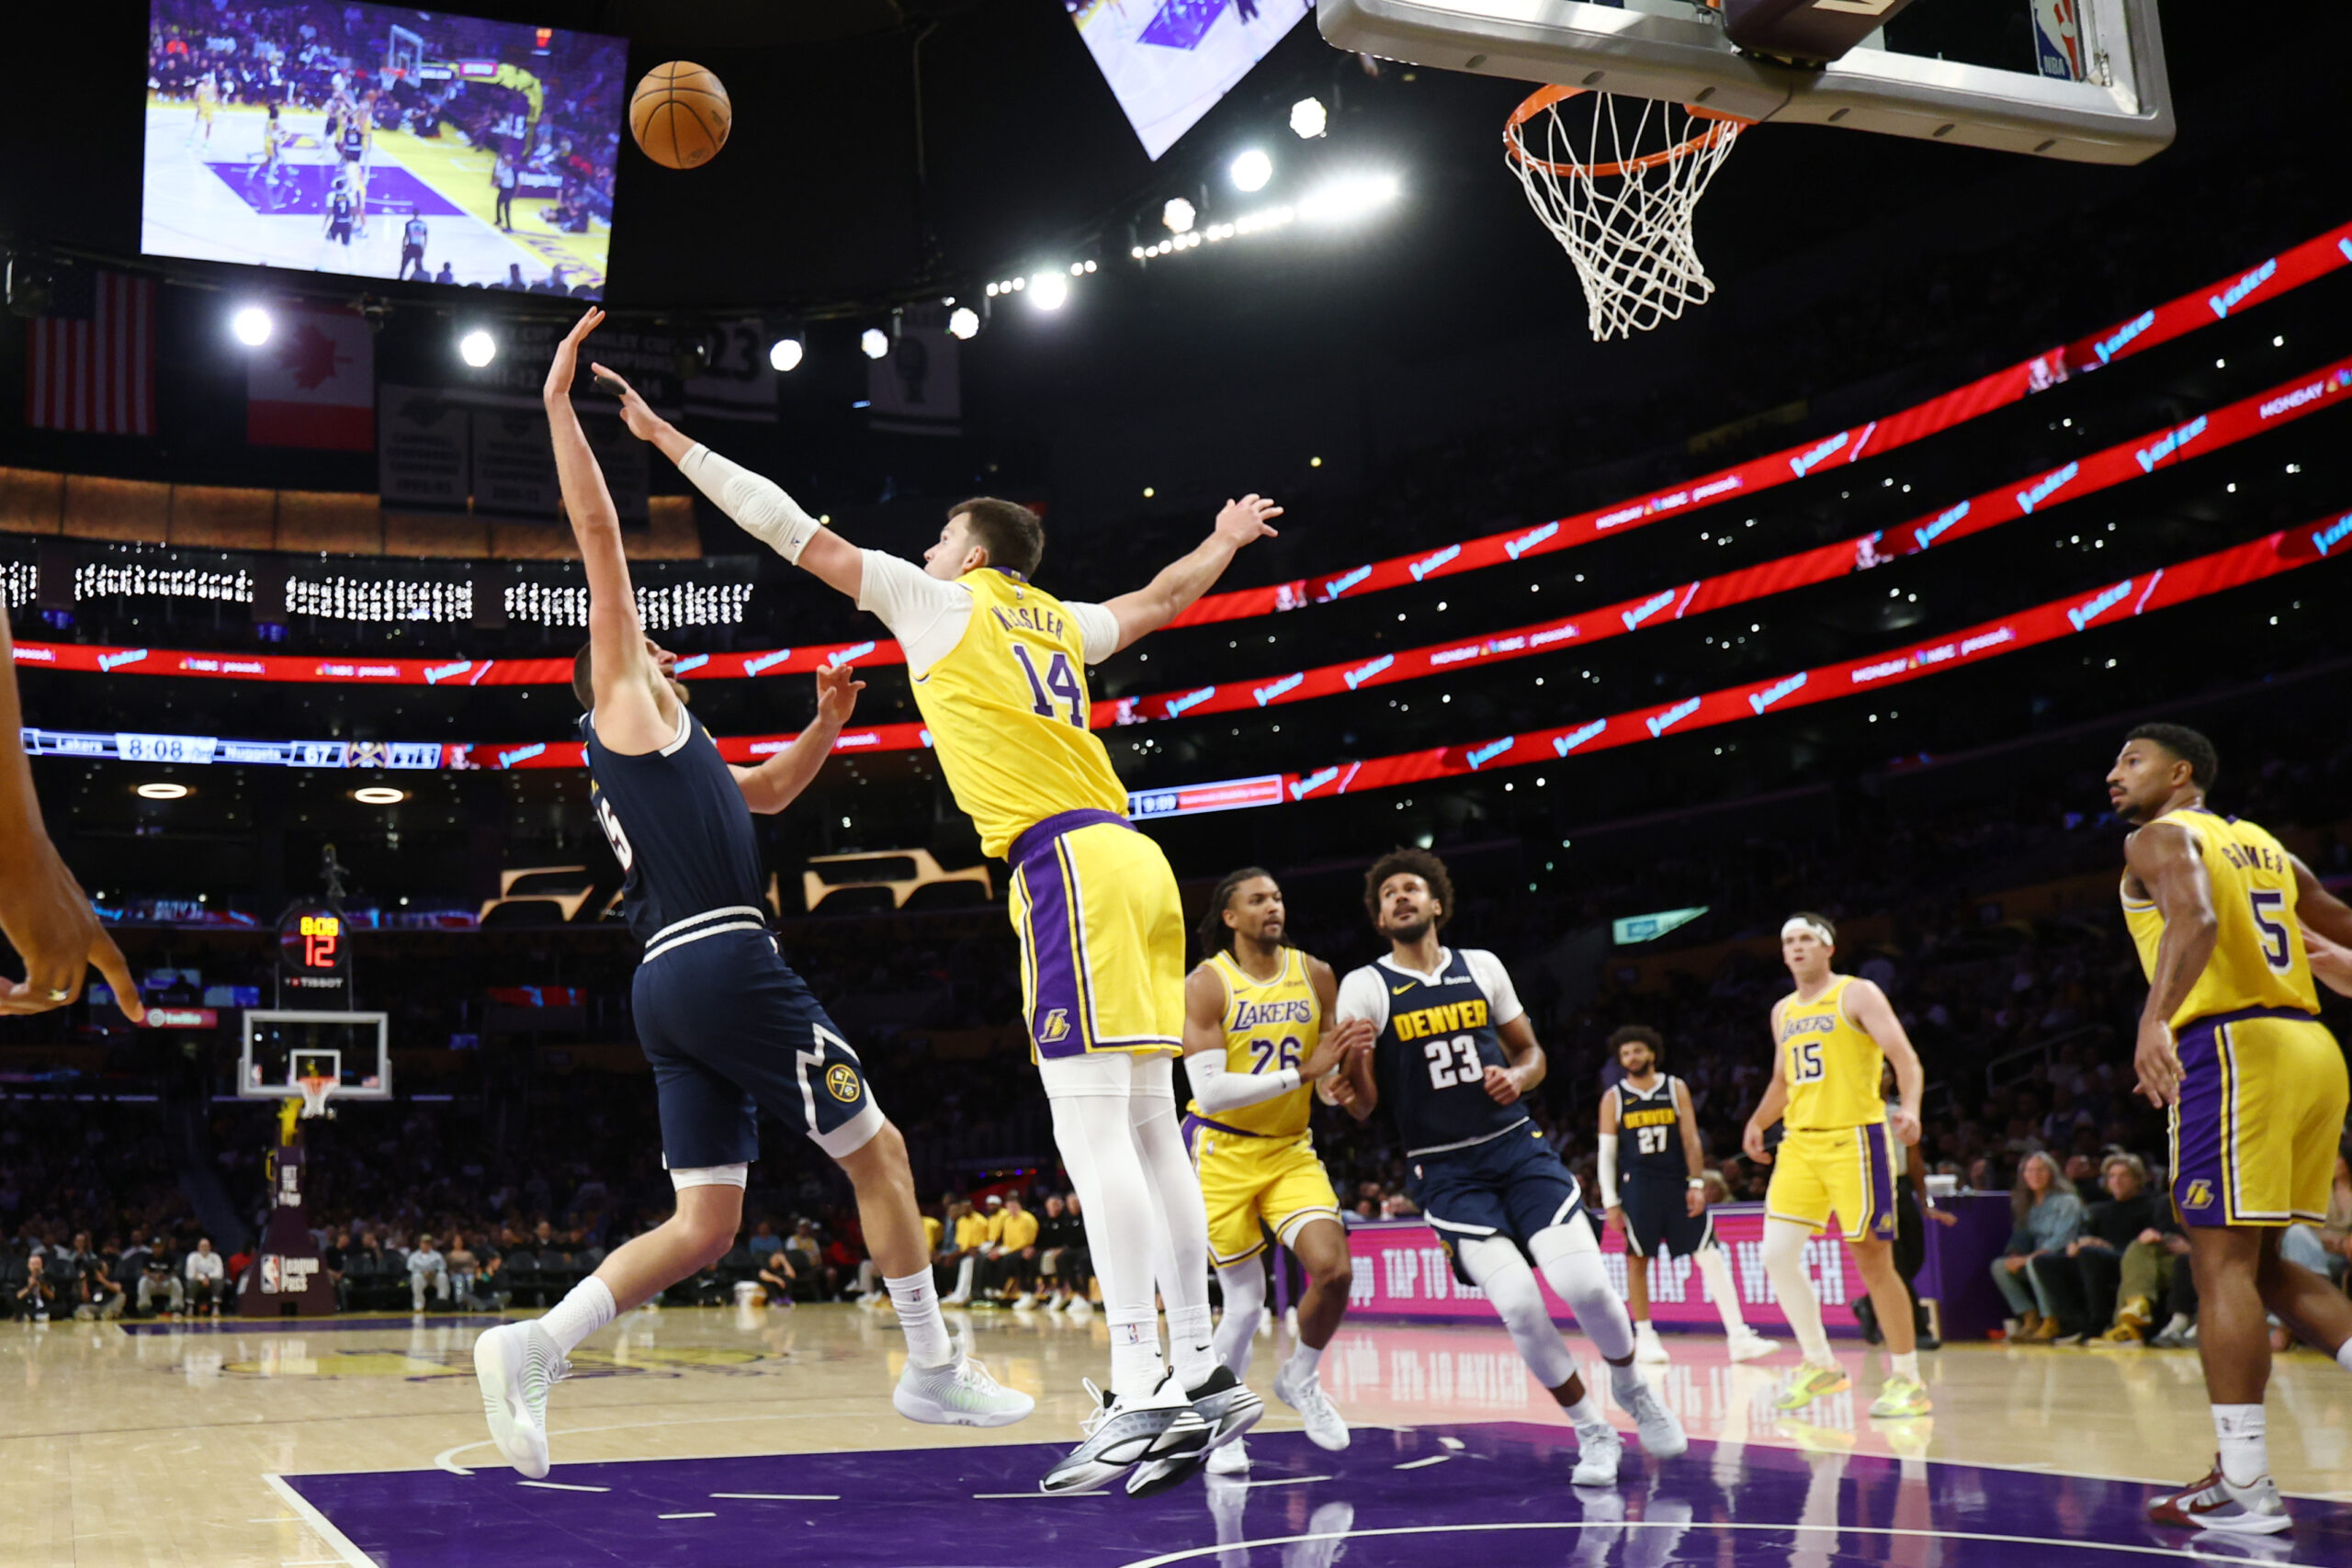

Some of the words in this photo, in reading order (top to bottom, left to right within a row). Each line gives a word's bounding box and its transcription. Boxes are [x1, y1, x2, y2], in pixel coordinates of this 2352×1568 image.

[2043, 56, 2066, 76] NBA
[2210, 257, 2277, 319] Voice
[2095, 310, 2155, 364] Voice
[2259, 381, 2324, 419] MONDAY
[1790, 431, 1849, 478] Voice
[2136, 415, 2207, 473] Voice
[2017, 461, 2078, 514] Voice
[1915, 501, 1970, 549] Voice
[1622, 589, 1675, 631] Voice
[2068, 580, 2132, 631] Voice
[673, 653, 709, 673] oice
[1012, 641, 1086, 730] 14
[1749, 671, 1807, 715] Voice
[1554, 718, 1607, 757] Voice
[1646, 696, 1701, 738] Voice
[129, 739, 185, 761] 8:08
[304, 744, 333, 765] 67
[300, 916, 339, 936] 8:08
[2248, 887, 2292, 975] 5
[305, 935, 336, 966] 12
[1228, 998, 1313, 1033] LAKERS
[1393, 998, 1487, 1042] DENVER
[1781, 1014, 1837, 1043] LAKERS
[1250, 1035, 1303, 1077] 26
[1424, 1034, 1484, 1089] 23
[1793, 1042, 1826, 1083] 15
[1623, 1108, 1676, 1130] DENVER
[1637, 1125, 1668, 1154] 27
[1382, 1248, 1419, 1299] TAP
[1419, 1247, 1448, 1300] TO
[1736, 1239, 1846, 1305] WCH
